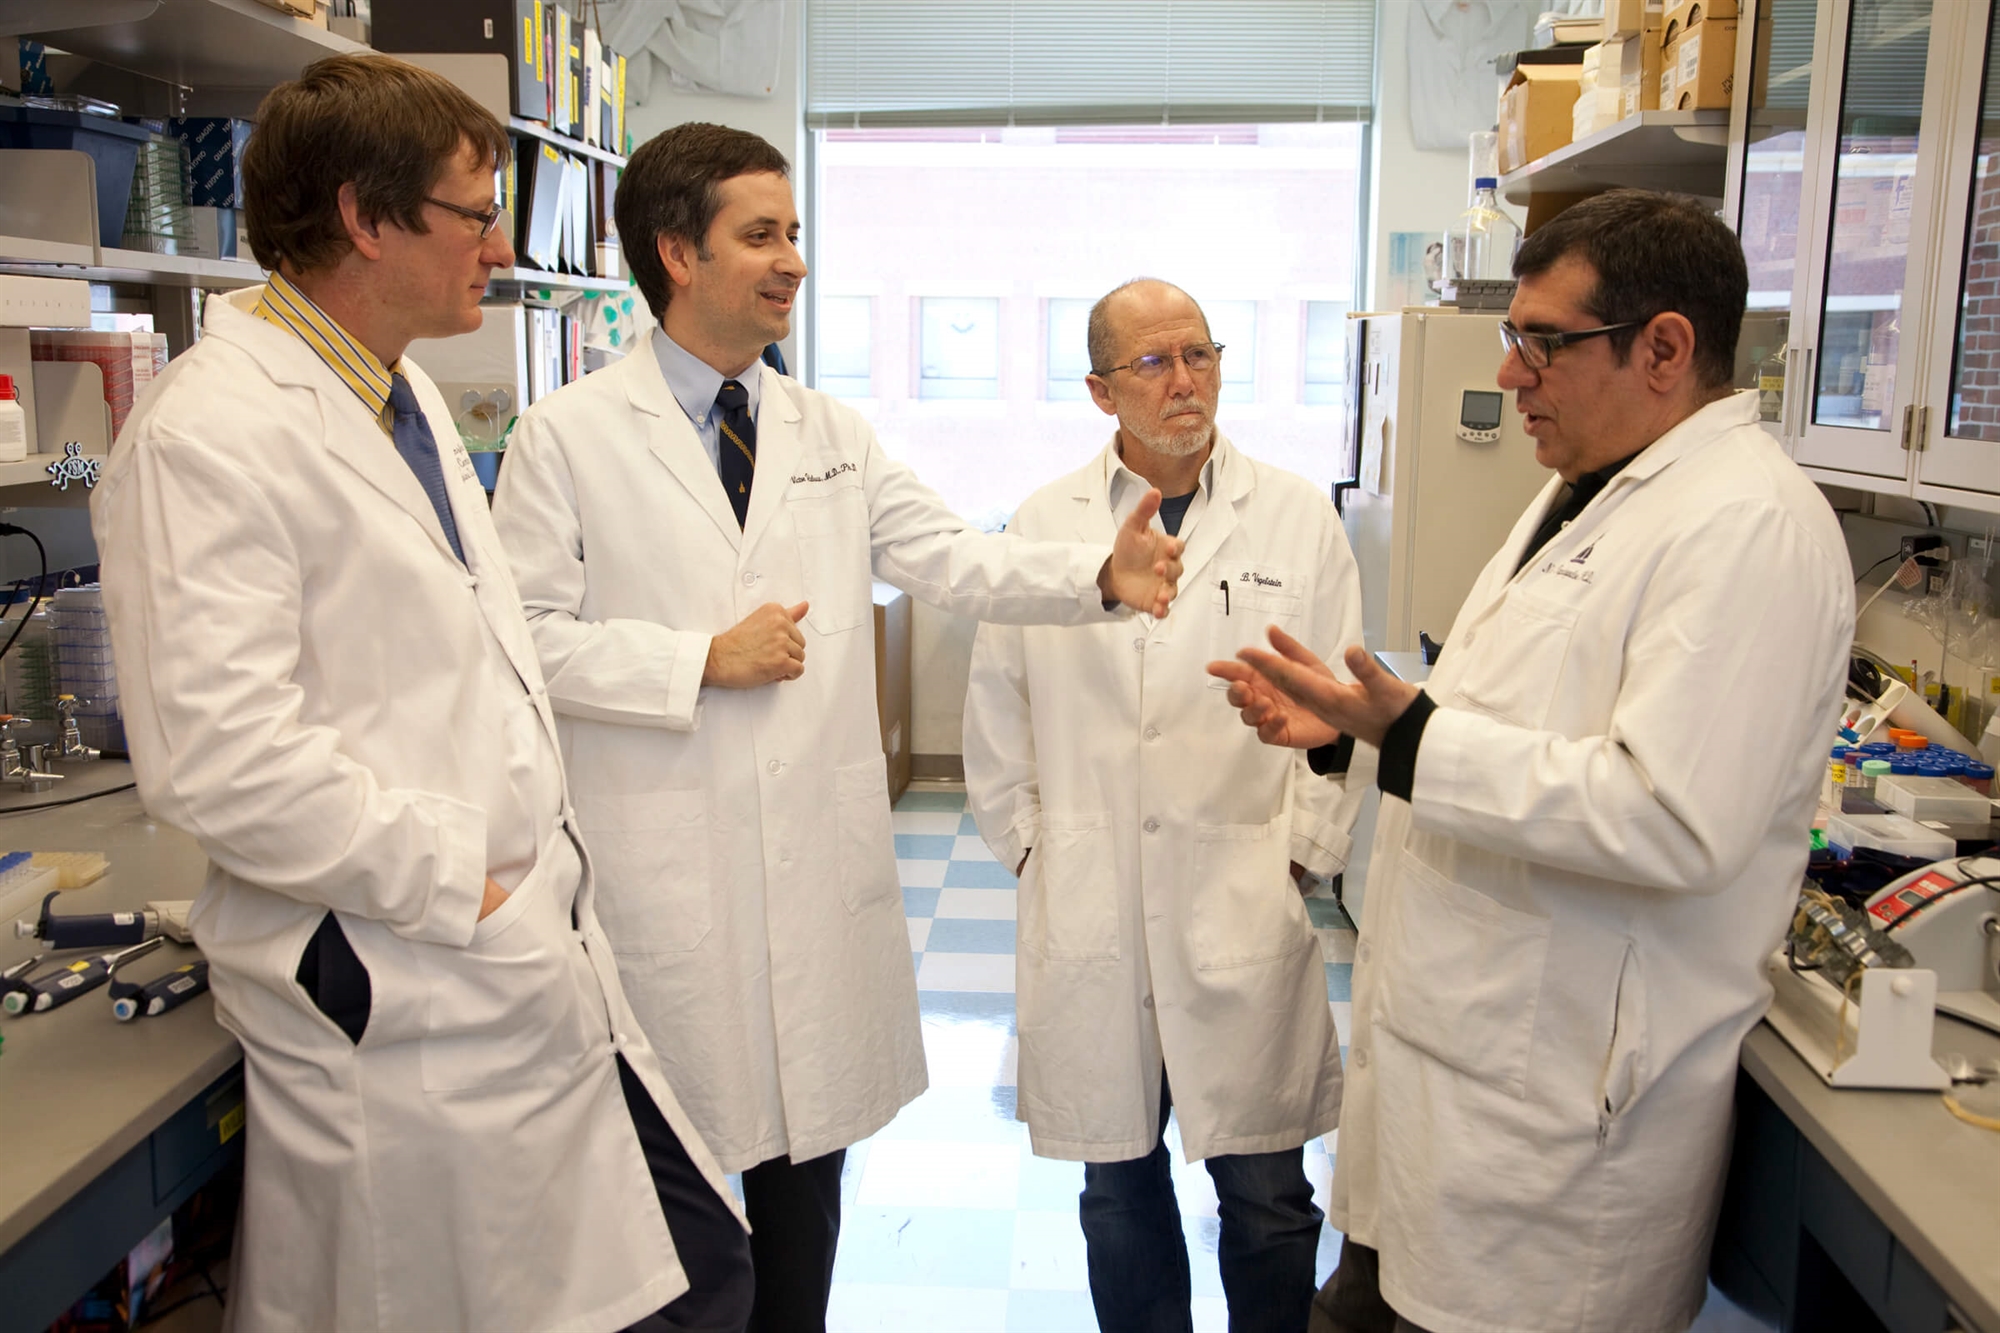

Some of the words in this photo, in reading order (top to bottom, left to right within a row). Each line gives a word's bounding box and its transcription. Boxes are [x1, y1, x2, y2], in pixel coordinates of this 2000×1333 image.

[195, 121, 215, 143] QIAGEN
[214, 140, 232, 161] QIAGEN
[205, 168, 224, 190] QIAGEN
[67, 460, 84, 475] FSM
[1240, 572, 1250, 582] B.
